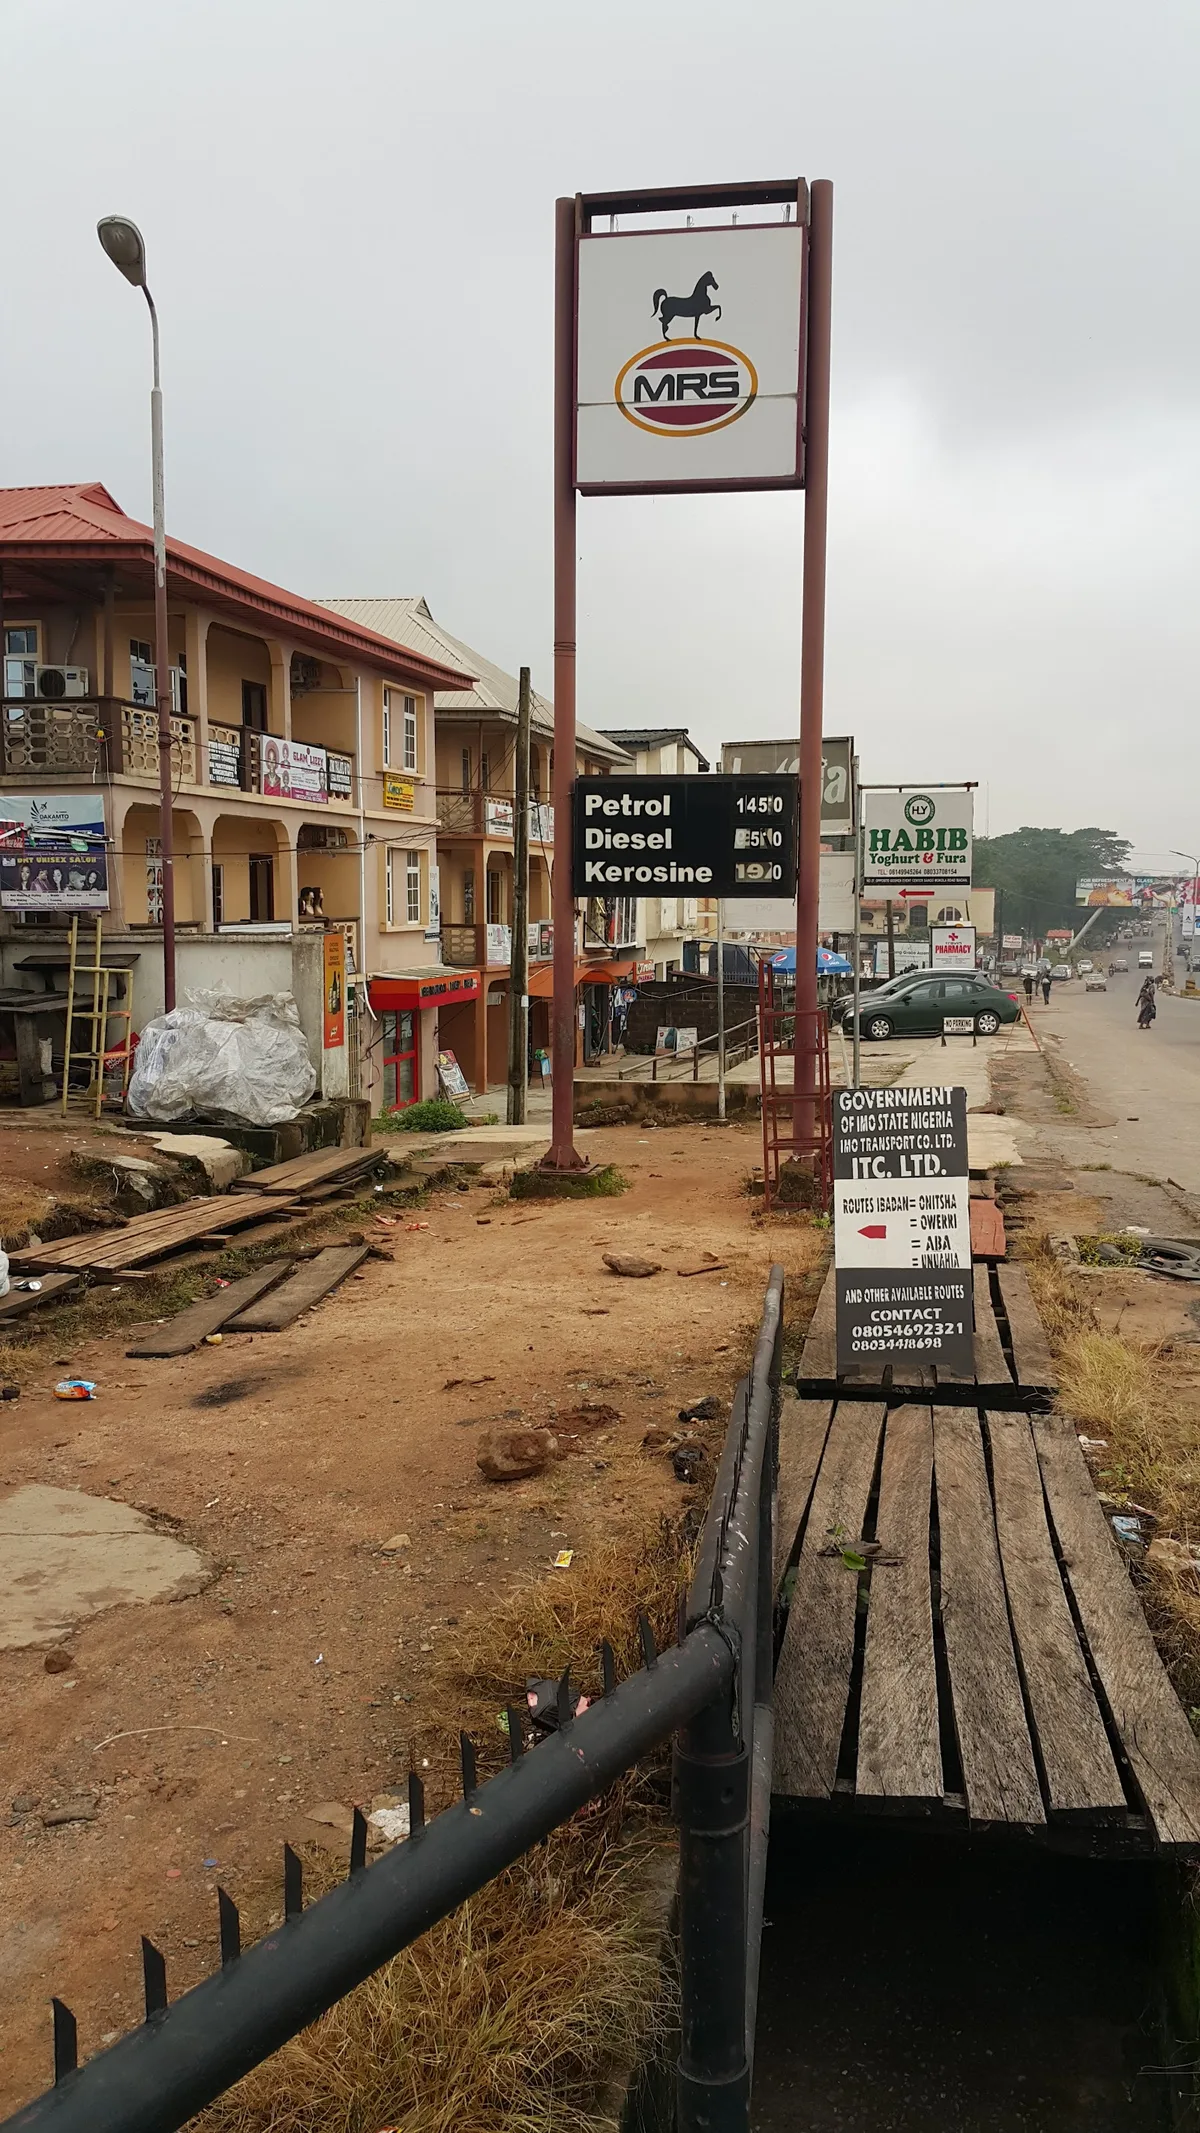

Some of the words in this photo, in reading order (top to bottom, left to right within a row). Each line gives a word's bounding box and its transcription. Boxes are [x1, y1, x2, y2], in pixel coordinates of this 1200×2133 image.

[634, 371, 740, 402] MRS
[585, 794, 671, 816] Petrol
[585, 828, 672, 849] Diesel
[869, 828, 968, 851] HABIB
[869, 853, 920, 867] Yoghurt
[922, 852, 934, 863] &
[936, 853, 966, 864] Fura
[585, 861, 713, 883] Kerosine
[935, 945, 971, 953] PHARMACY
[945, 1019, 952, 1028] NO
[953, 1019, 972, 1027] PARKING
[839, 1087, 953, 1111] GOVERNMENT
[840, 1115, 855, 1133] OF
[856, 1113, 876, 1132] IMO
[878, 1112, 908, 1131] STATE
[911, 1111, 953, 1130] NIGERIA
[840, 1138, 858, 1153] IMO
[860, 1135, 914, 1152] TRANSPORT
[916, 1134, 934, 1149] CO.
[935, 1133, 956, 1149] LTD.
[851, 1156, 892, 1179] ITC.
[900, 1153, 947, 1177] LTD.
[843, 1197, 874, 1214] ROUTES
[918, 1194, 957, 1211] ONITSHA
[920, 1213, 957, 1230] OWERRI
[926, 1235, 951, 1251] ABA
[845, 1288, 862, 1304] AND
[863, 1287, 890, 1302] OTHER
[891, 1285, 932, 1302] AVAILABLE
[934, 1284, 964, 1300] ROUTES
[870, 1307, 942, 1322] CONTACT
[852, 1322, 963, 1338] 08054692321
